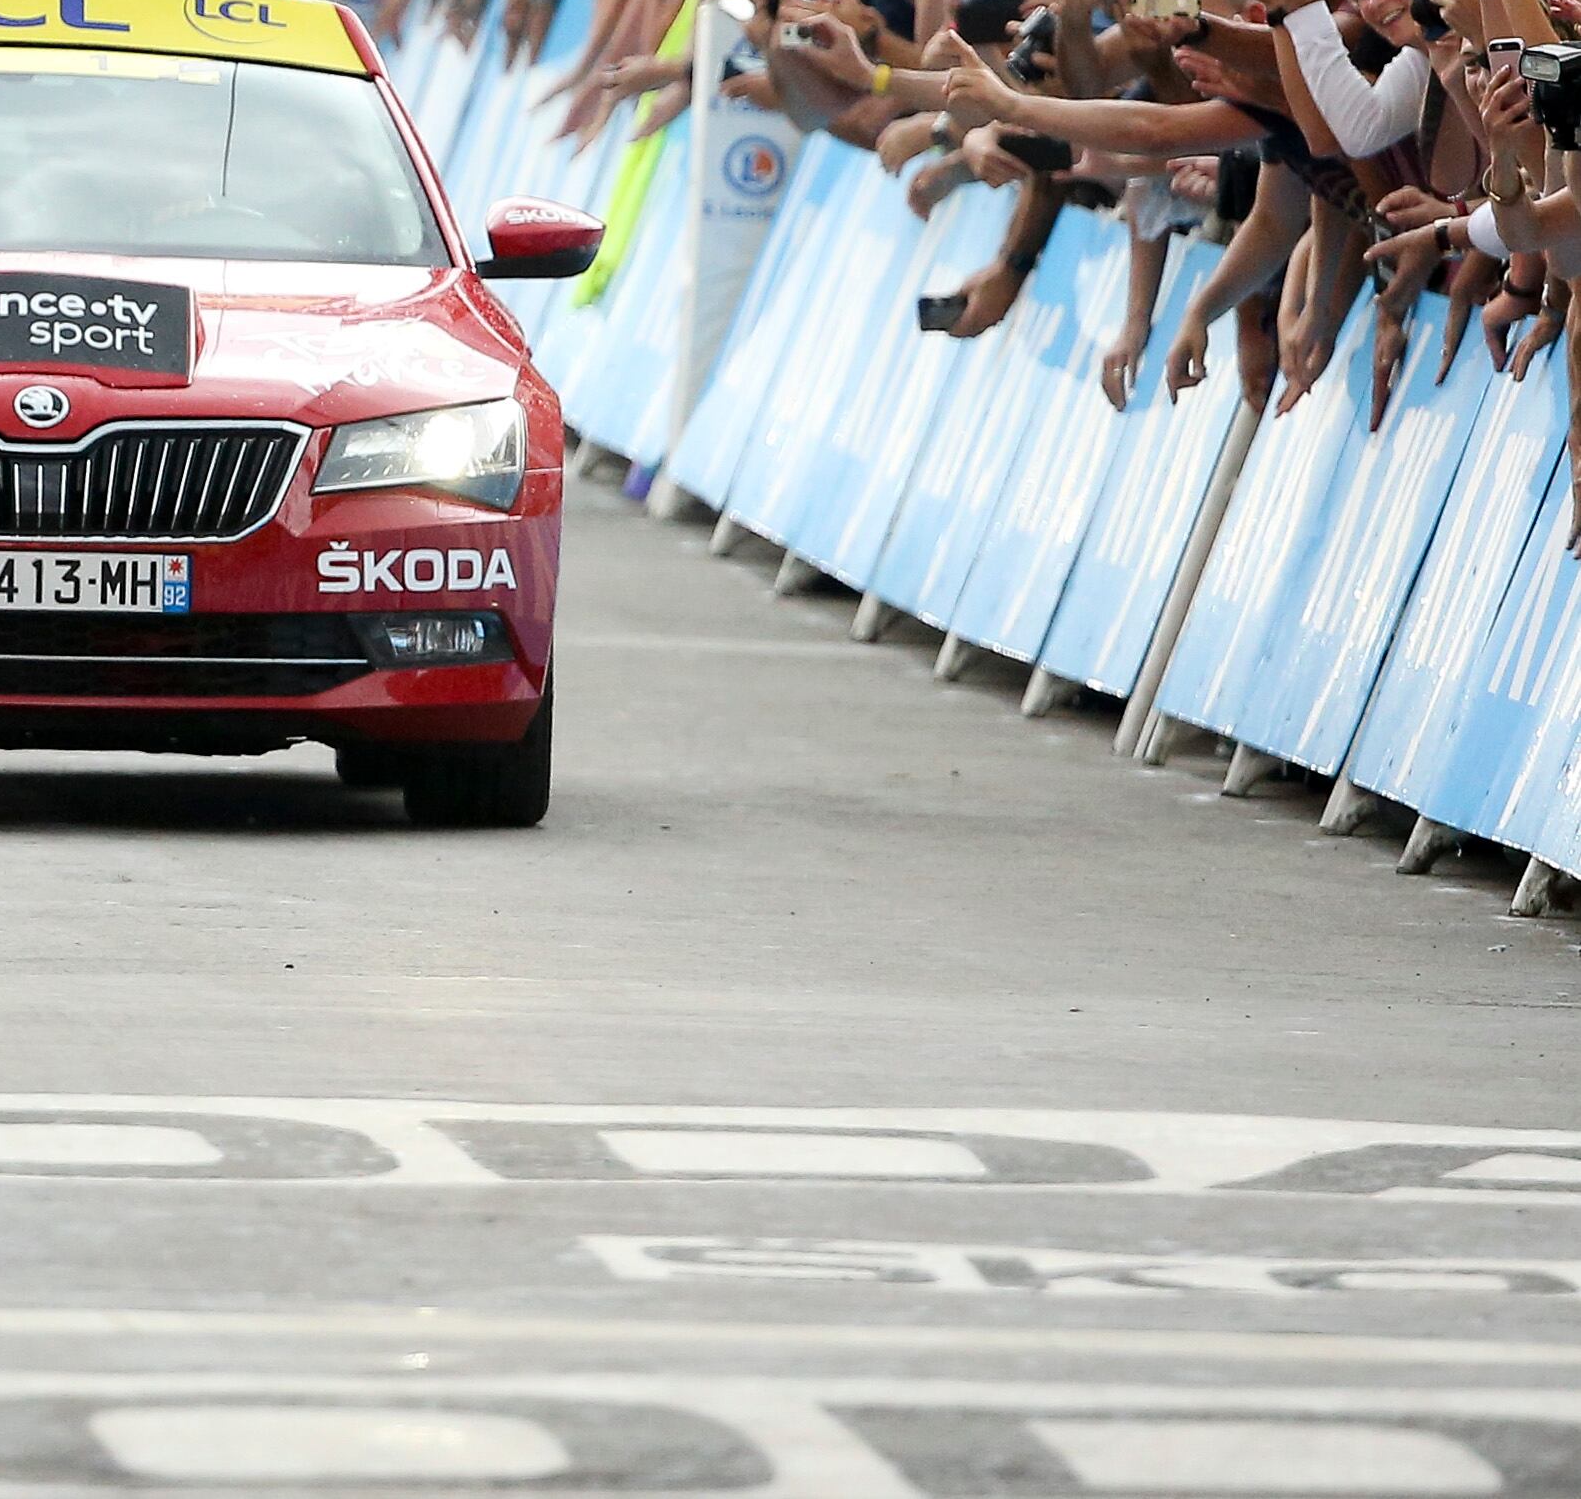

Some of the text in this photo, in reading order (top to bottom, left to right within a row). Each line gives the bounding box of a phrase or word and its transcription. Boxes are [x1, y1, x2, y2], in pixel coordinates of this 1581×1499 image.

[28, 321, 156, 356] sport
[316, 540, 518, 593] ŠKODA
[163, 586, 187, 607] 92
